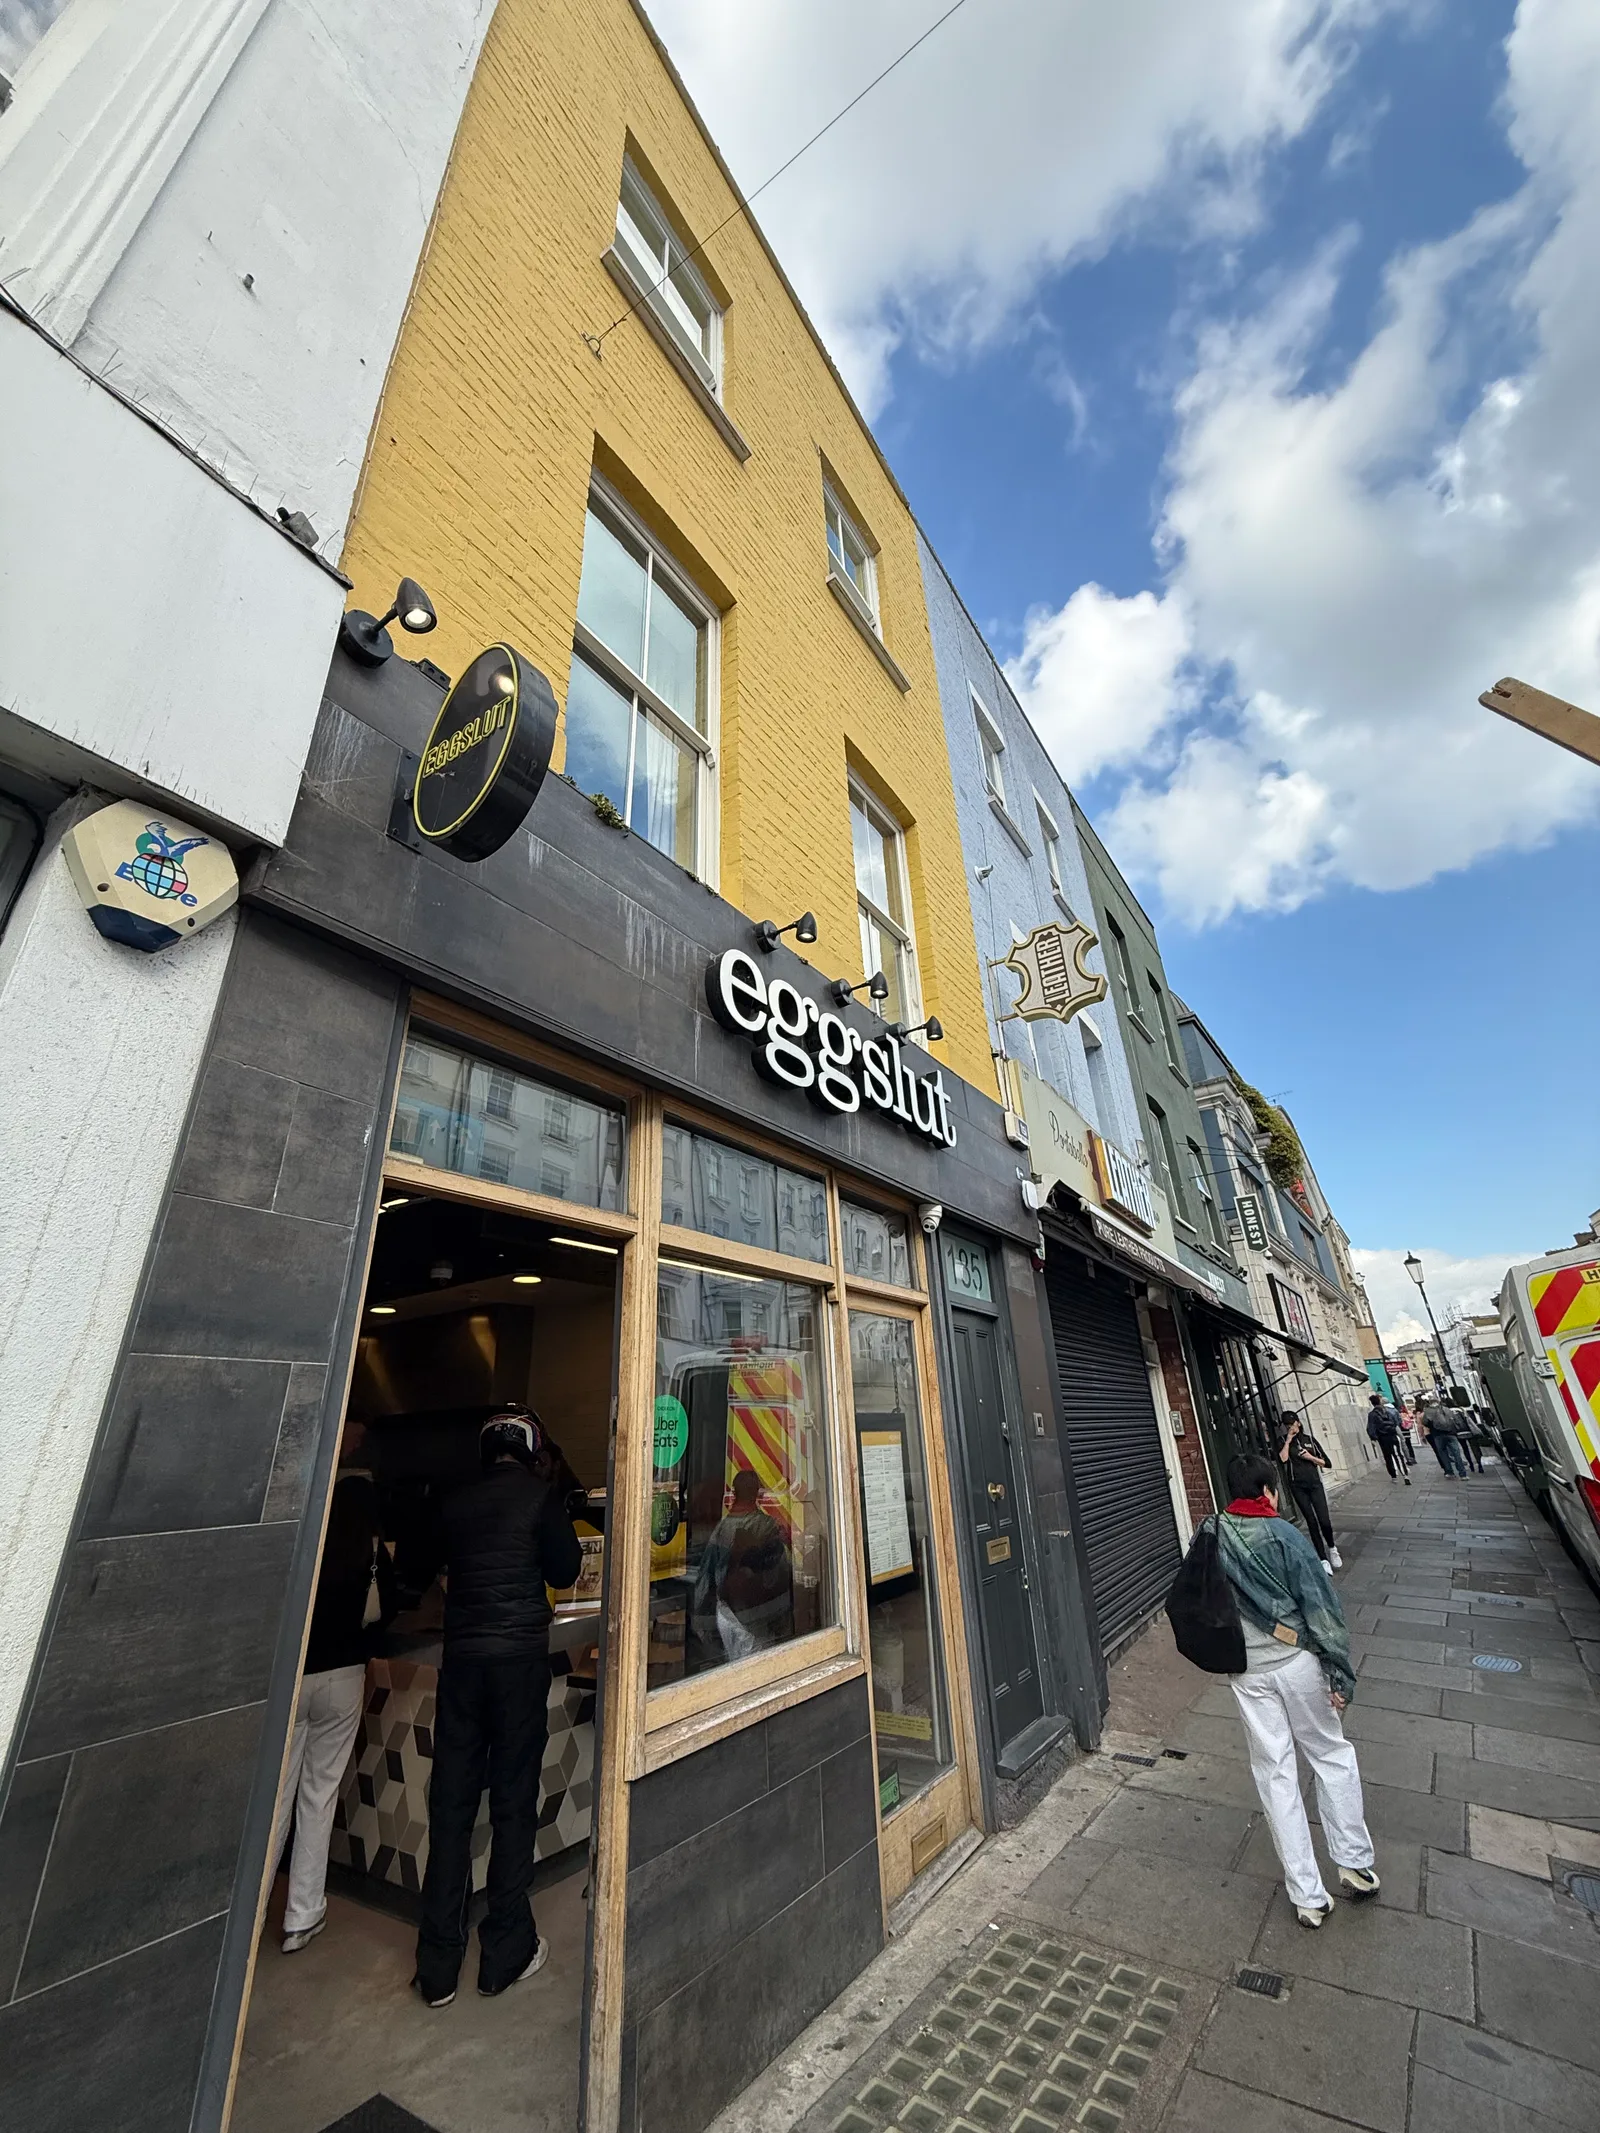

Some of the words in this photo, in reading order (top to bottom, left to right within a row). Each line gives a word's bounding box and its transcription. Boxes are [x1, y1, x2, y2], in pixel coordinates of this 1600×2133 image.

[423, 696, 511, 778] EGGSLUT
[1035, 934, 1071, 1005] LEATHER
[719, 949, 957, 1148] eggslut
[1241, 1199, 1264, 1246] HONEST
[653, 1433, 678, 1448] Eats
